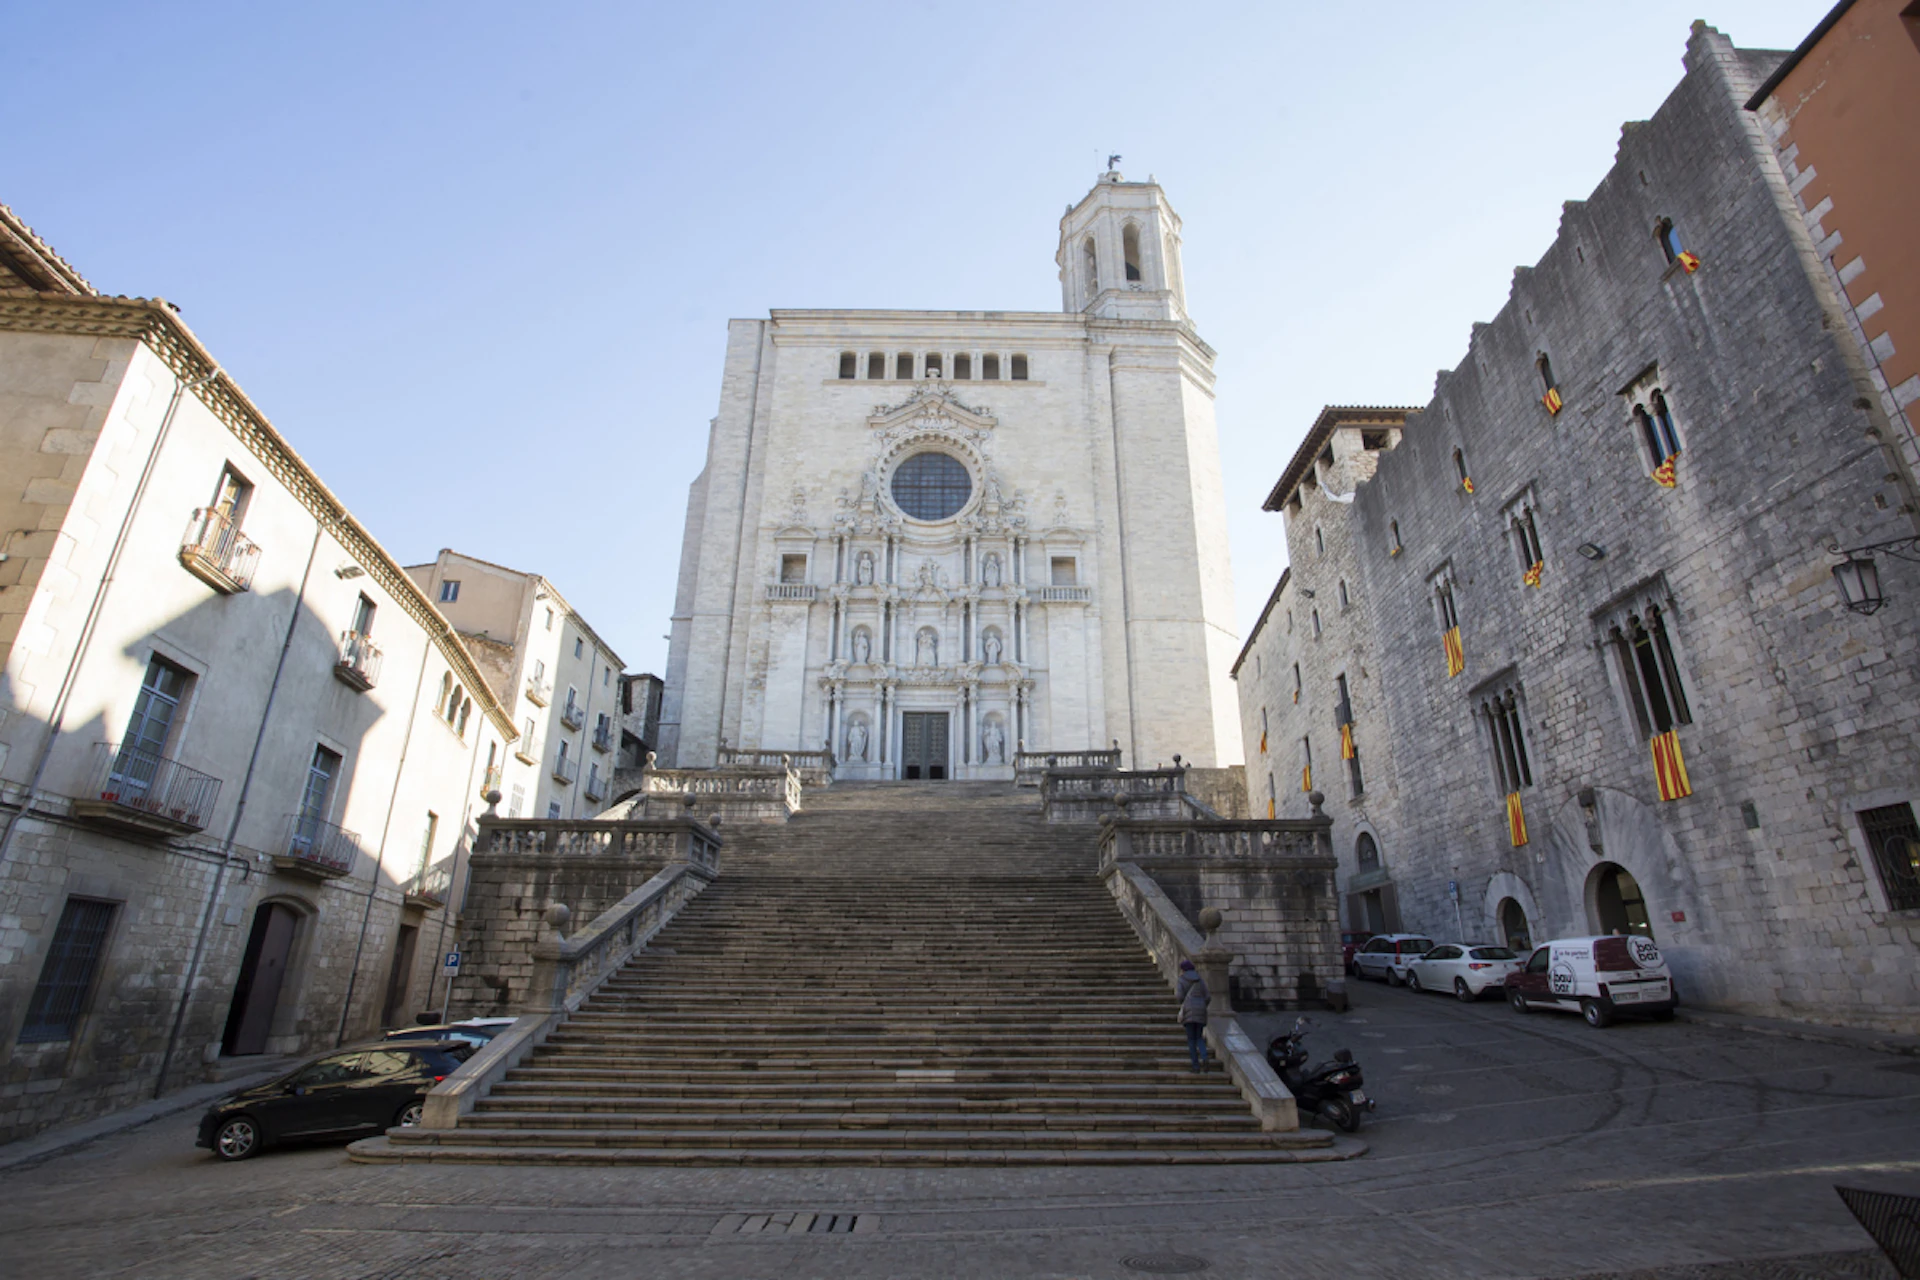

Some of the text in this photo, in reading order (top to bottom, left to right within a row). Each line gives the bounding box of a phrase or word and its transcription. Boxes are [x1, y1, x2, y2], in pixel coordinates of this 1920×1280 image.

[447, 954, 457, 966] P
[1637, 950, 1659, 961] bar
[1553, 970, 1572, 983] bau
[1553, 981, 1569, 993] bar
